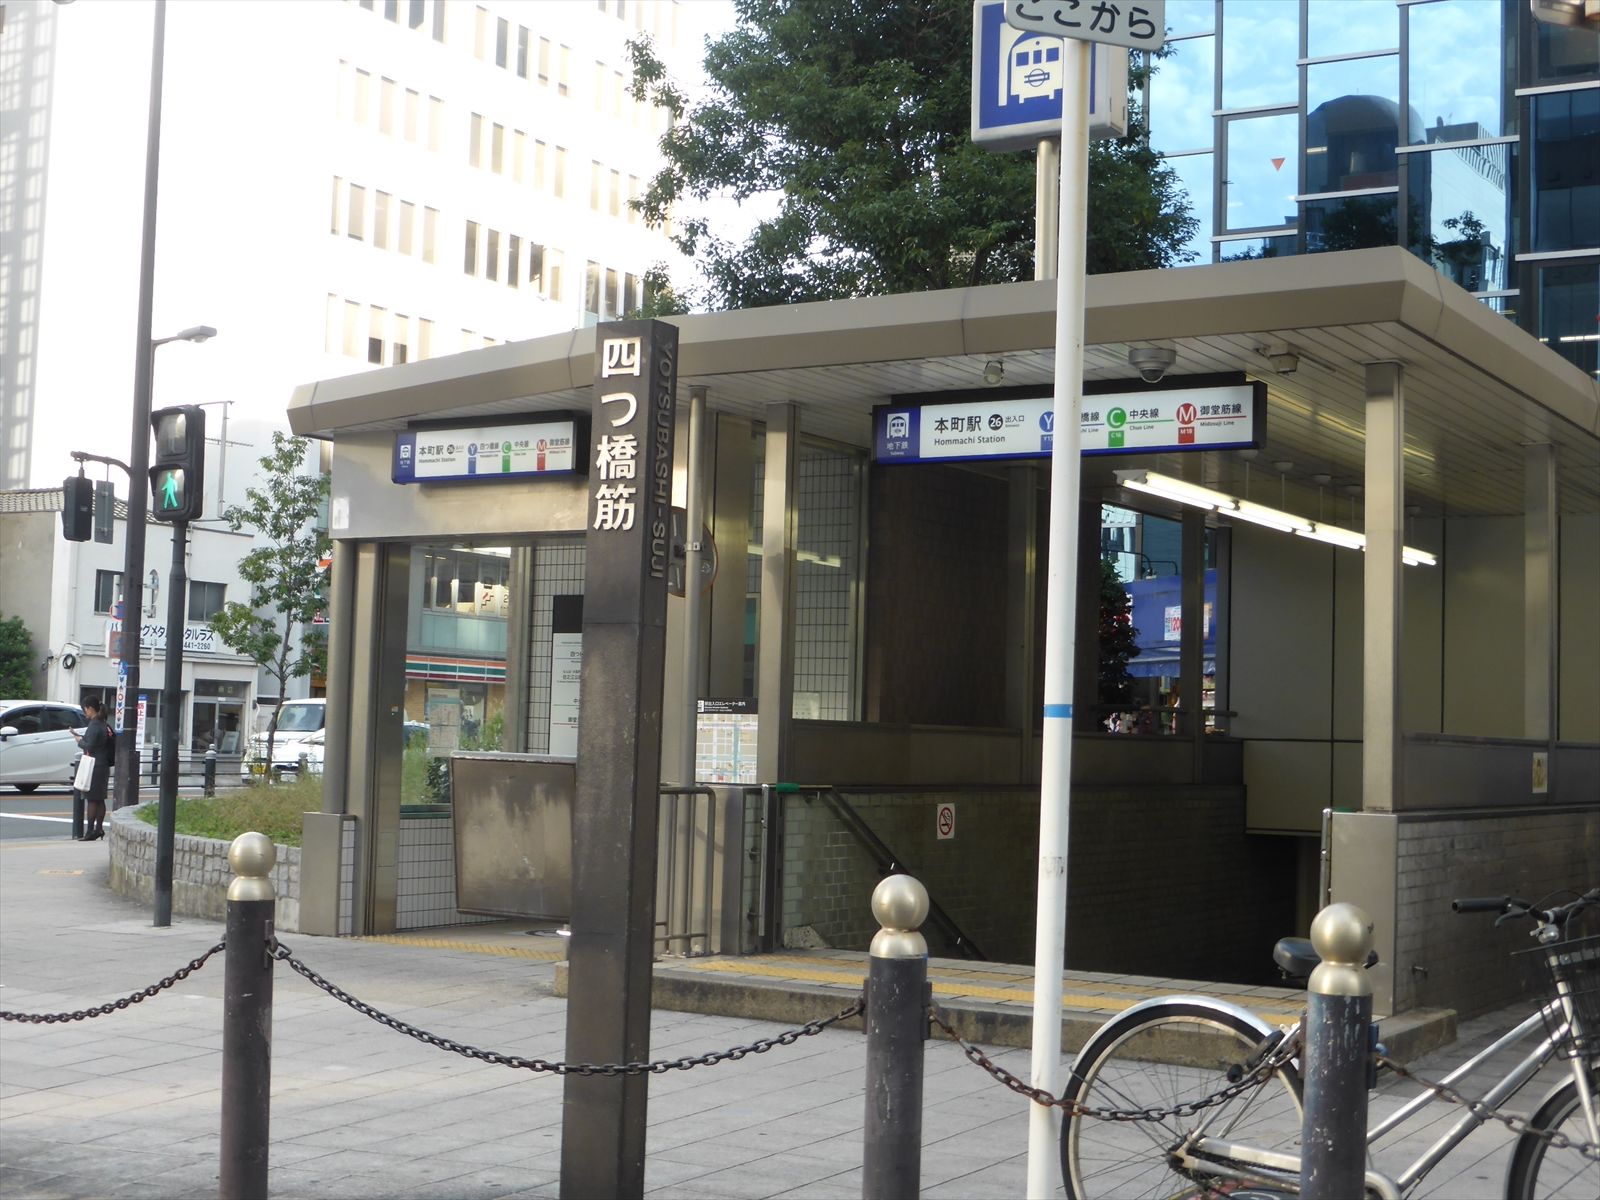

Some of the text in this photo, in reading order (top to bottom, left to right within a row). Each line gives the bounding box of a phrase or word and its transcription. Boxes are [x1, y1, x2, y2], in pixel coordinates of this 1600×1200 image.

[1015, 0, 1156, 39] ここから
[1129, 408, 1159, 420] 中央線
[1179, 405, 1194, 422] M
[1200, 403, 1242, 416] 御堂筋線
[934, 415, 982, 434] 本町駅
[989, 417, 1002, 428] 26
[1005, 414, 1025, 424] 出入口
[1043, 414, 1054, 430] Y
[1110, 409, 1121, 426] C
[593, 336, 642, 531] 四つ橋筋
[934, 435, 1006, 446] Hommachi Station
[418, 445, 444, 456] 本町駅
[650, 340, 676, 578] YOTSUBASHI-SUJI
[183, 641, 211, 650] 441-2260
